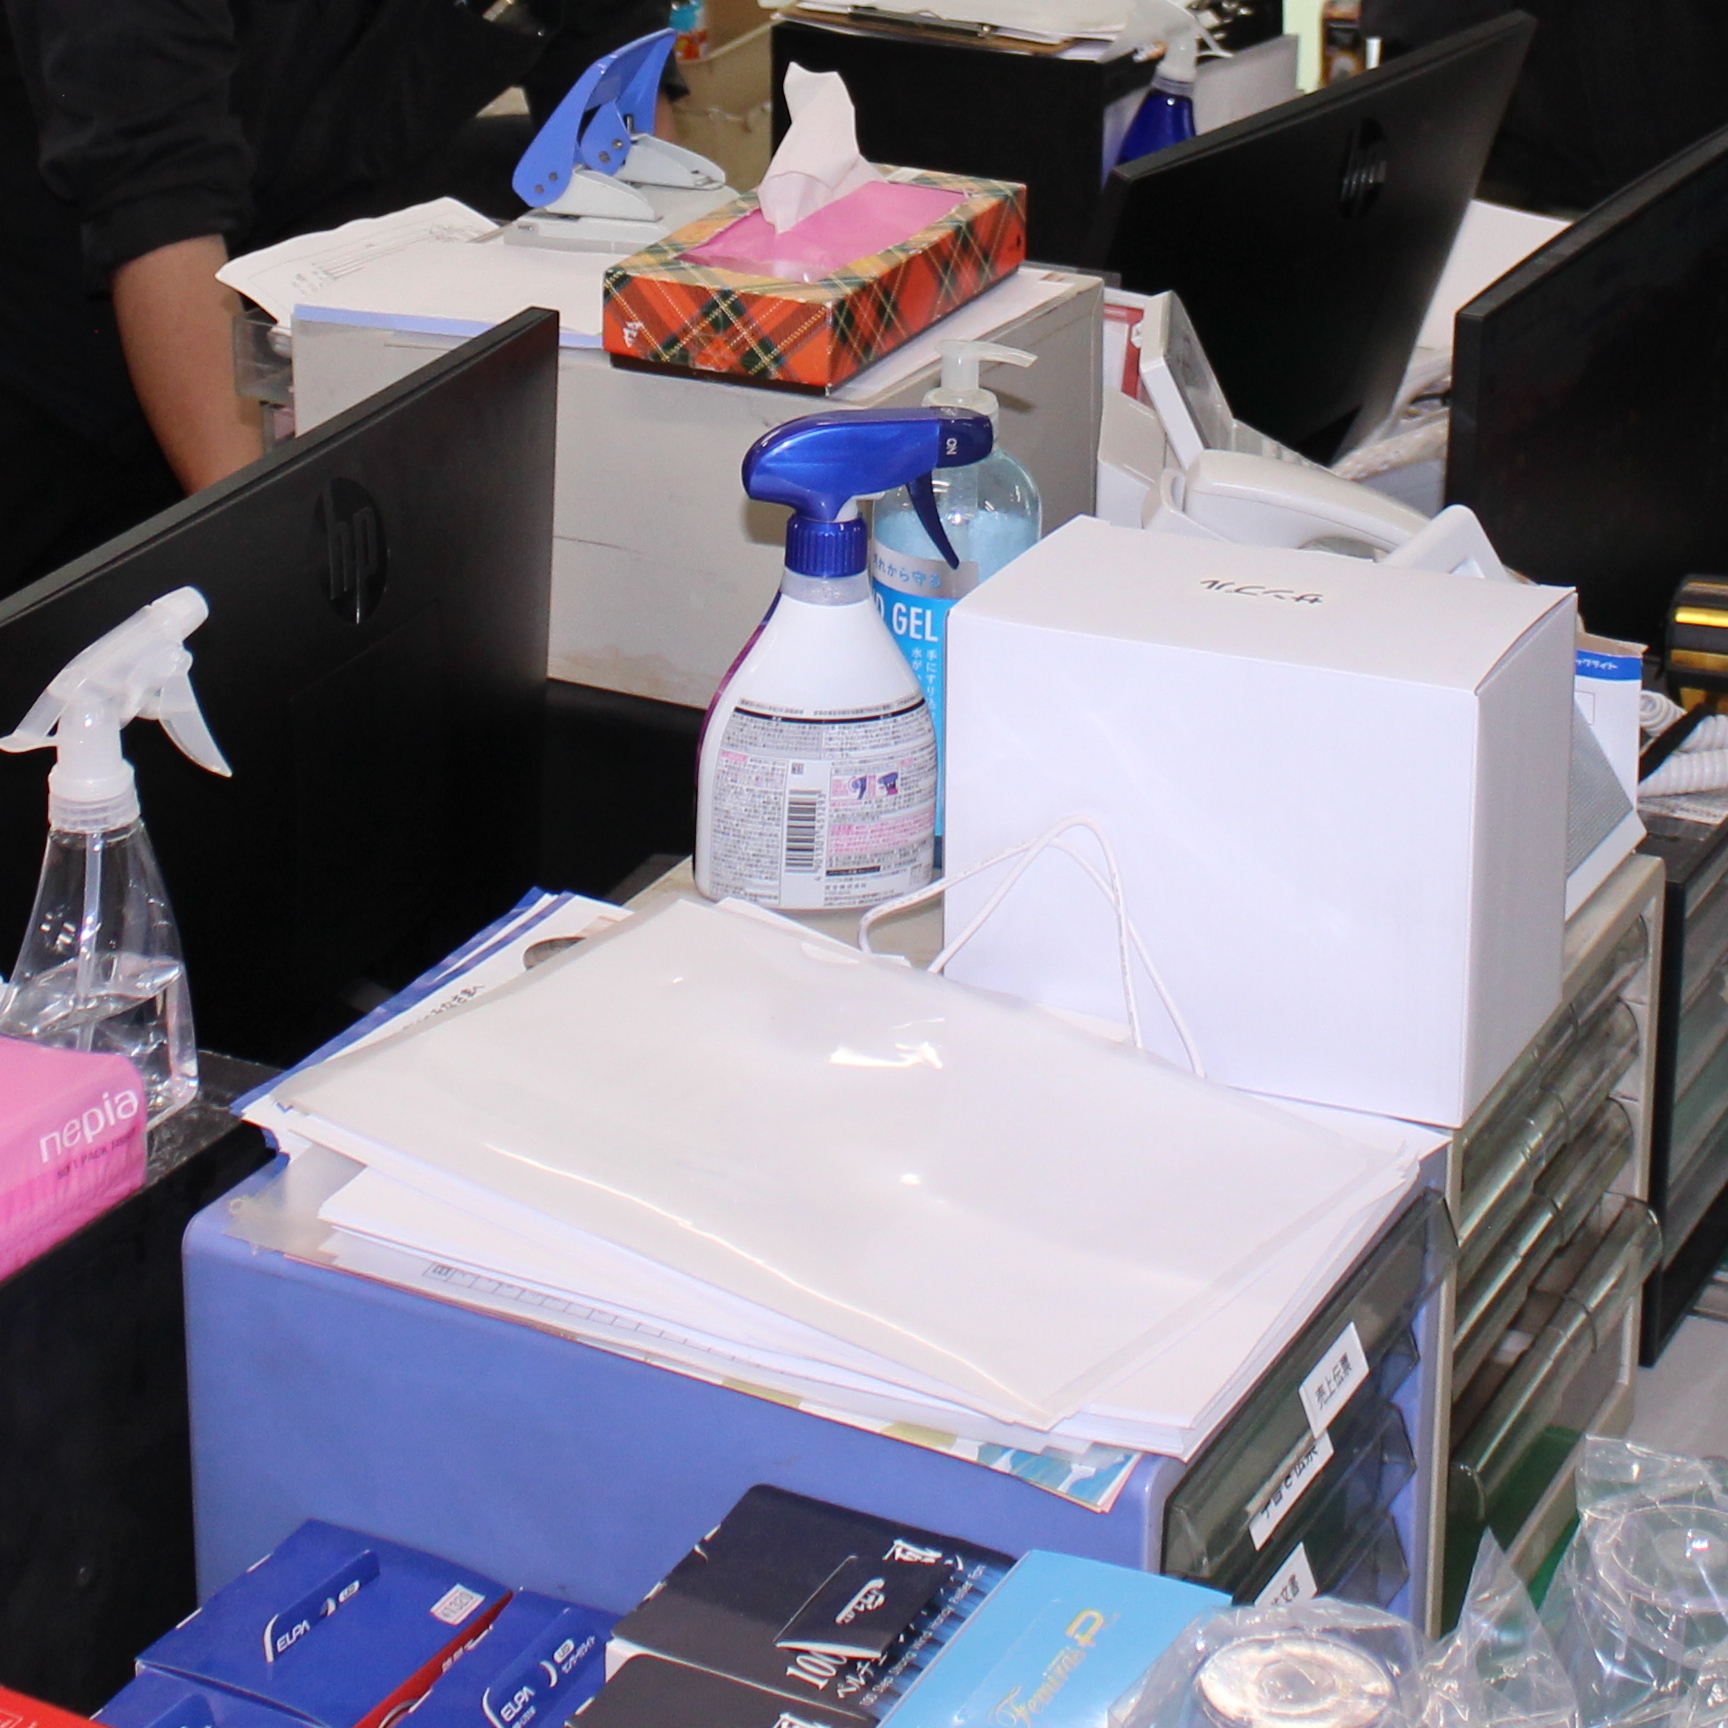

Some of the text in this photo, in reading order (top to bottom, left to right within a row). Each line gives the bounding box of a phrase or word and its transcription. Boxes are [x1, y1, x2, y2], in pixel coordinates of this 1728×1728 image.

[892, 603, 939, 643] GEL
[38, 1084, 140, 1164] nepia
[1314, 1351, 1353, 1411] 売上伝票
[276, 1619, 311, 1653] ELPA
[500, 1685, 536, 1723] ELPA
